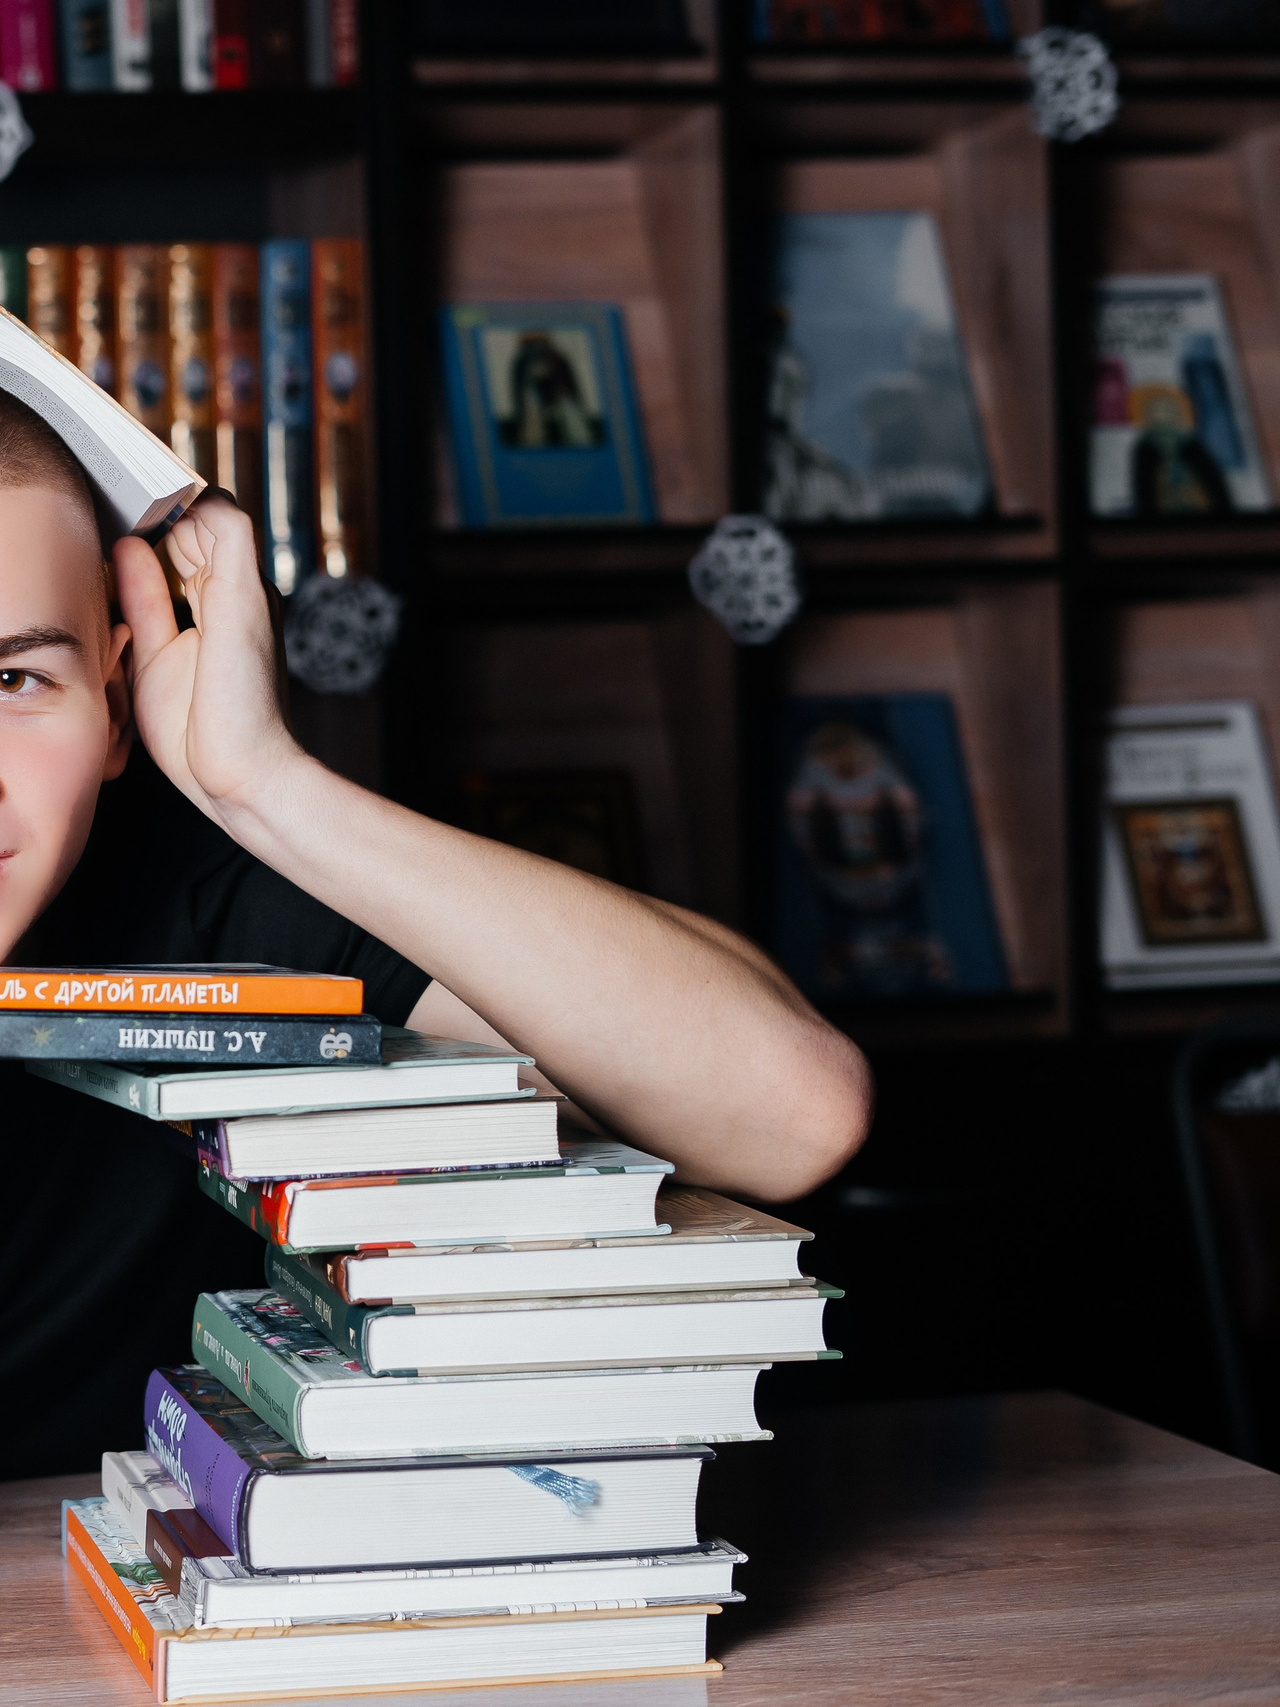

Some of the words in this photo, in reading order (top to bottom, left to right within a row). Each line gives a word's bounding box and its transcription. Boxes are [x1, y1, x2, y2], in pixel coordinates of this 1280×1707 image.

[34, 981, 49, 999] С
[54, 977, 135, 1006] ДРУГОЙ
[141, 981, 239, 1005] ПЛАНЕТЫ
[118, 1028, 215, 1051] ПУШКИН
